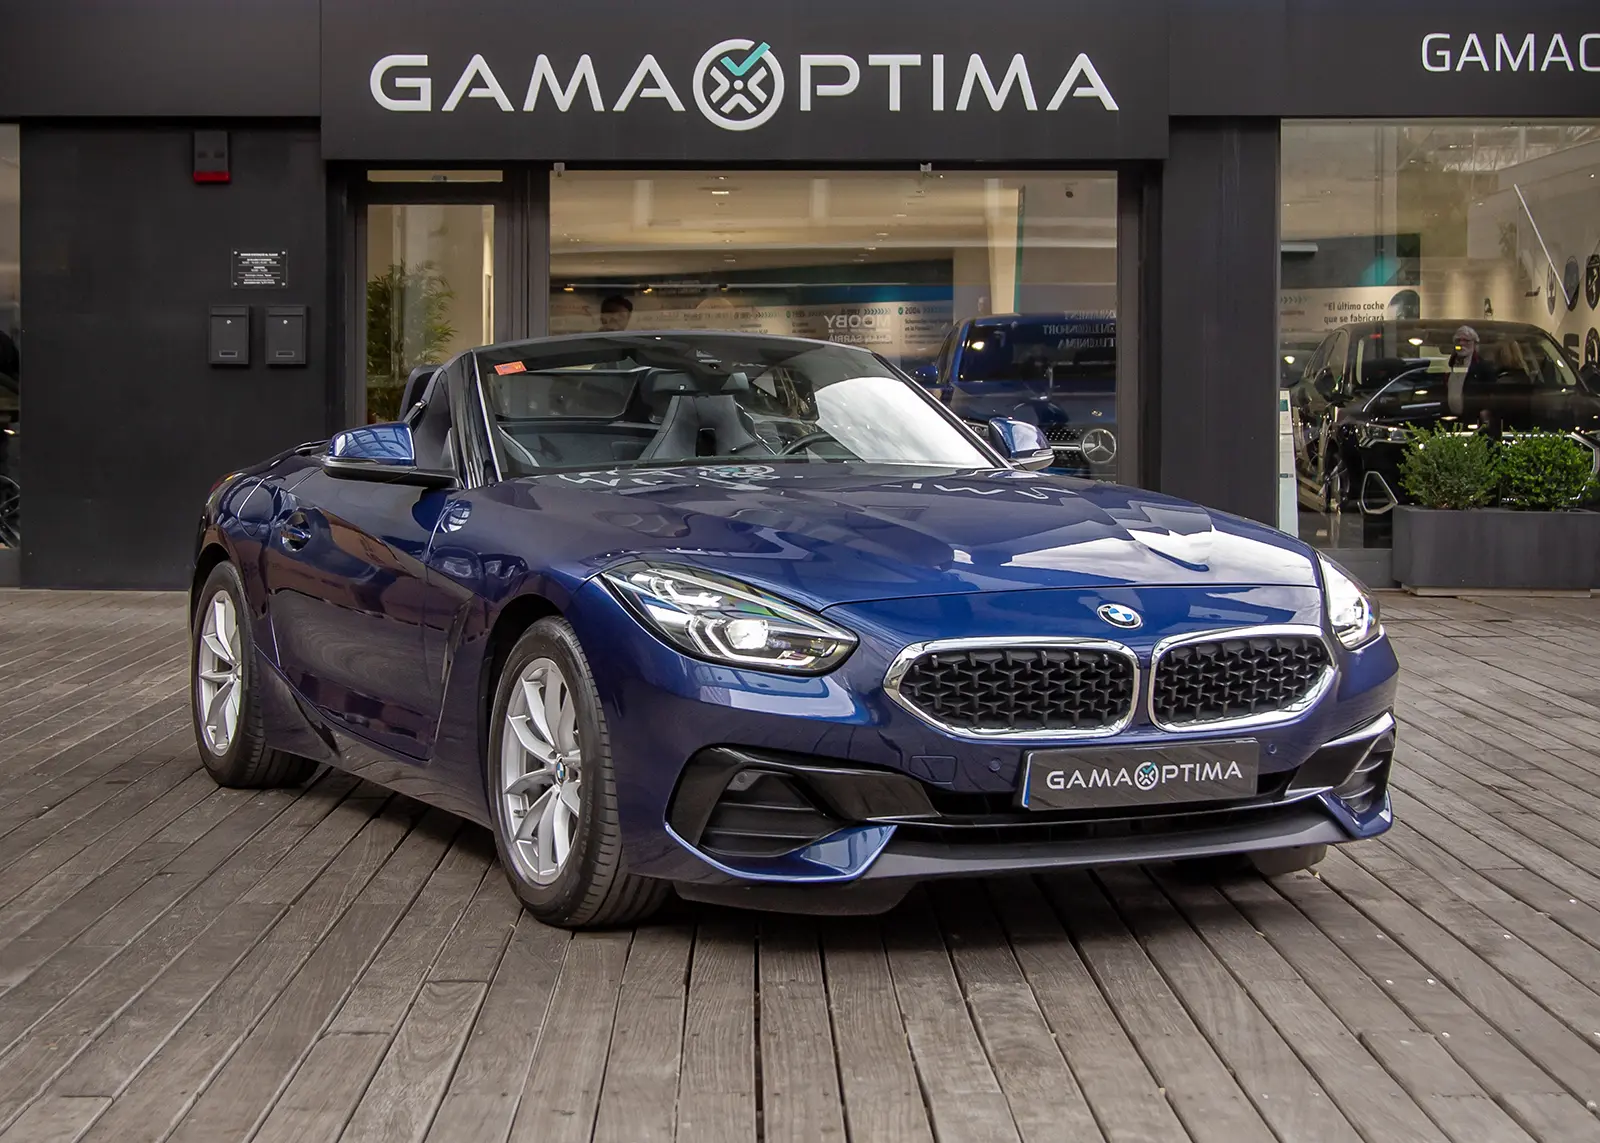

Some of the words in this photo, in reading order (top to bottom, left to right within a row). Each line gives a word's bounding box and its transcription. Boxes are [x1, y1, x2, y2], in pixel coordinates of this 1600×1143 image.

[1337, 301, 1361, 311] último
[1362, 301, 1385, 311] coche
[1323, 315, 1338, 324] que
[1339, 315, 1348, 323] se
